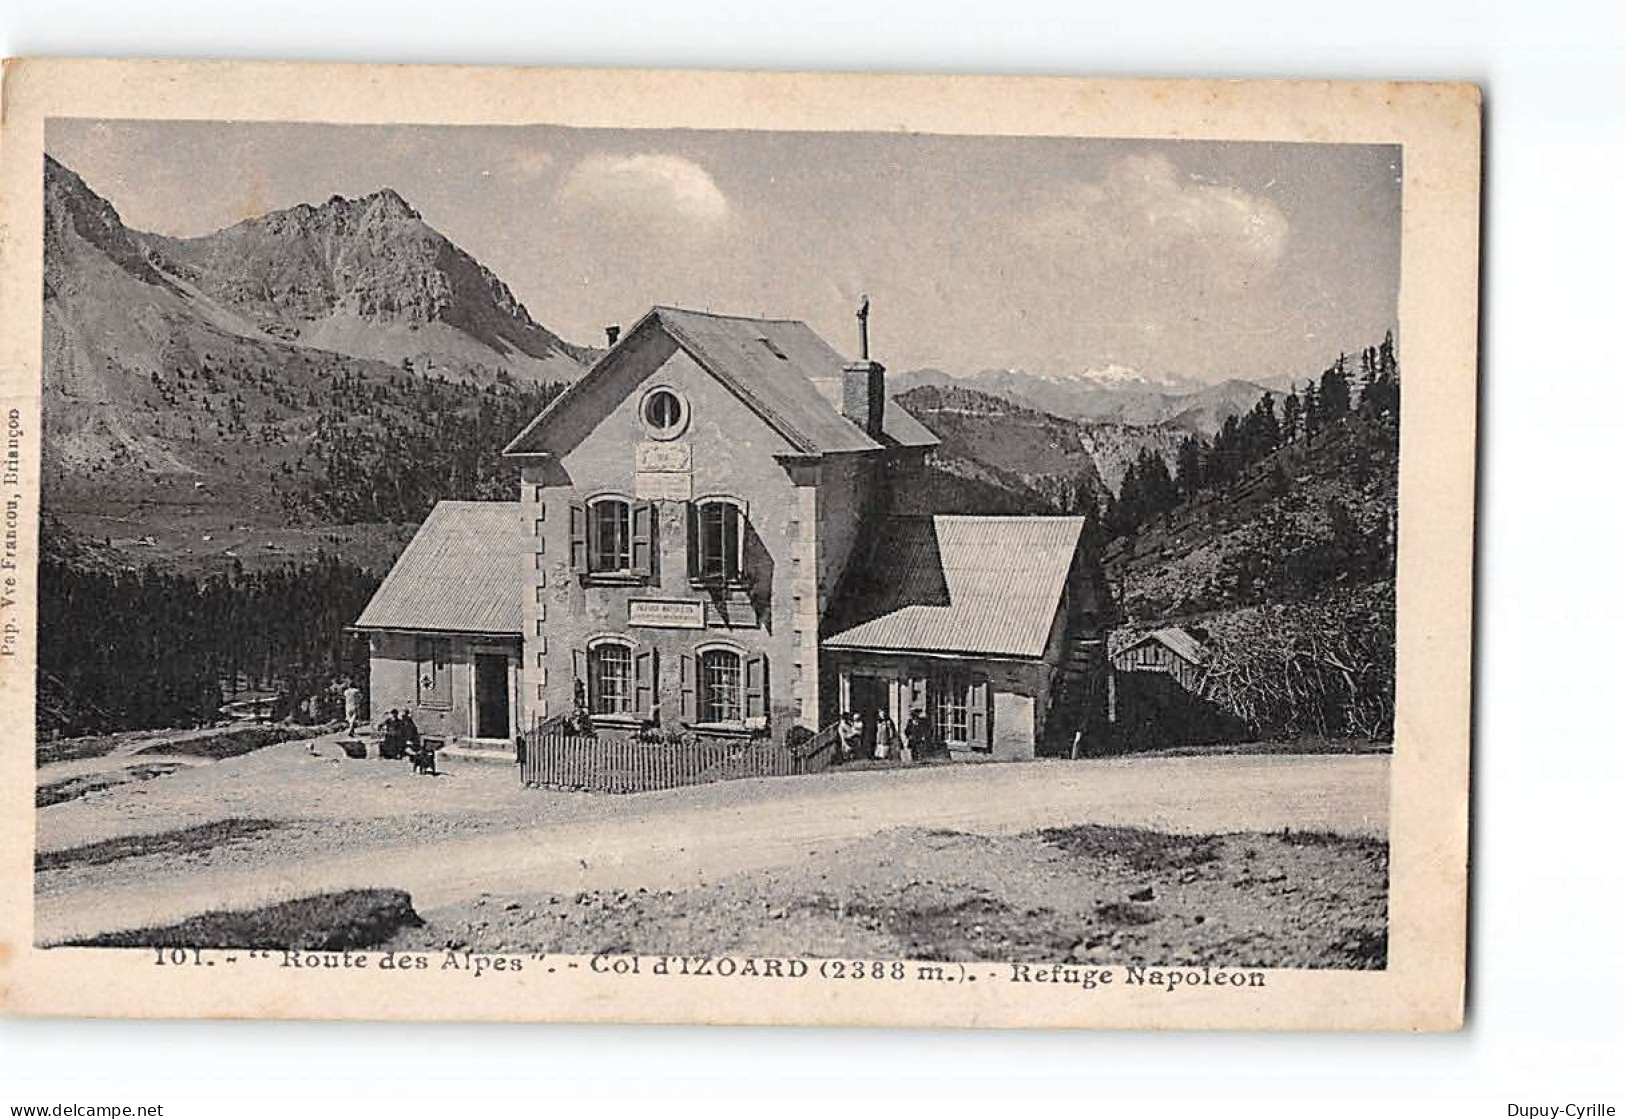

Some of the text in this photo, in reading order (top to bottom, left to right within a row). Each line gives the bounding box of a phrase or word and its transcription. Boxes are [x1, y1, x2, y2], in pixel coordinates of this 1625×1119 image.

[0, 408, 24, 657] Pap. Vve Francou, Briançon
[379, 951, 428, 969] des
[590, 954, 640, 974] Col
[653, 957, 808, 977] d'IZOARD
[819, 961, 905, 979] (2388
[1010, 964, 1113, 989] Refuge
